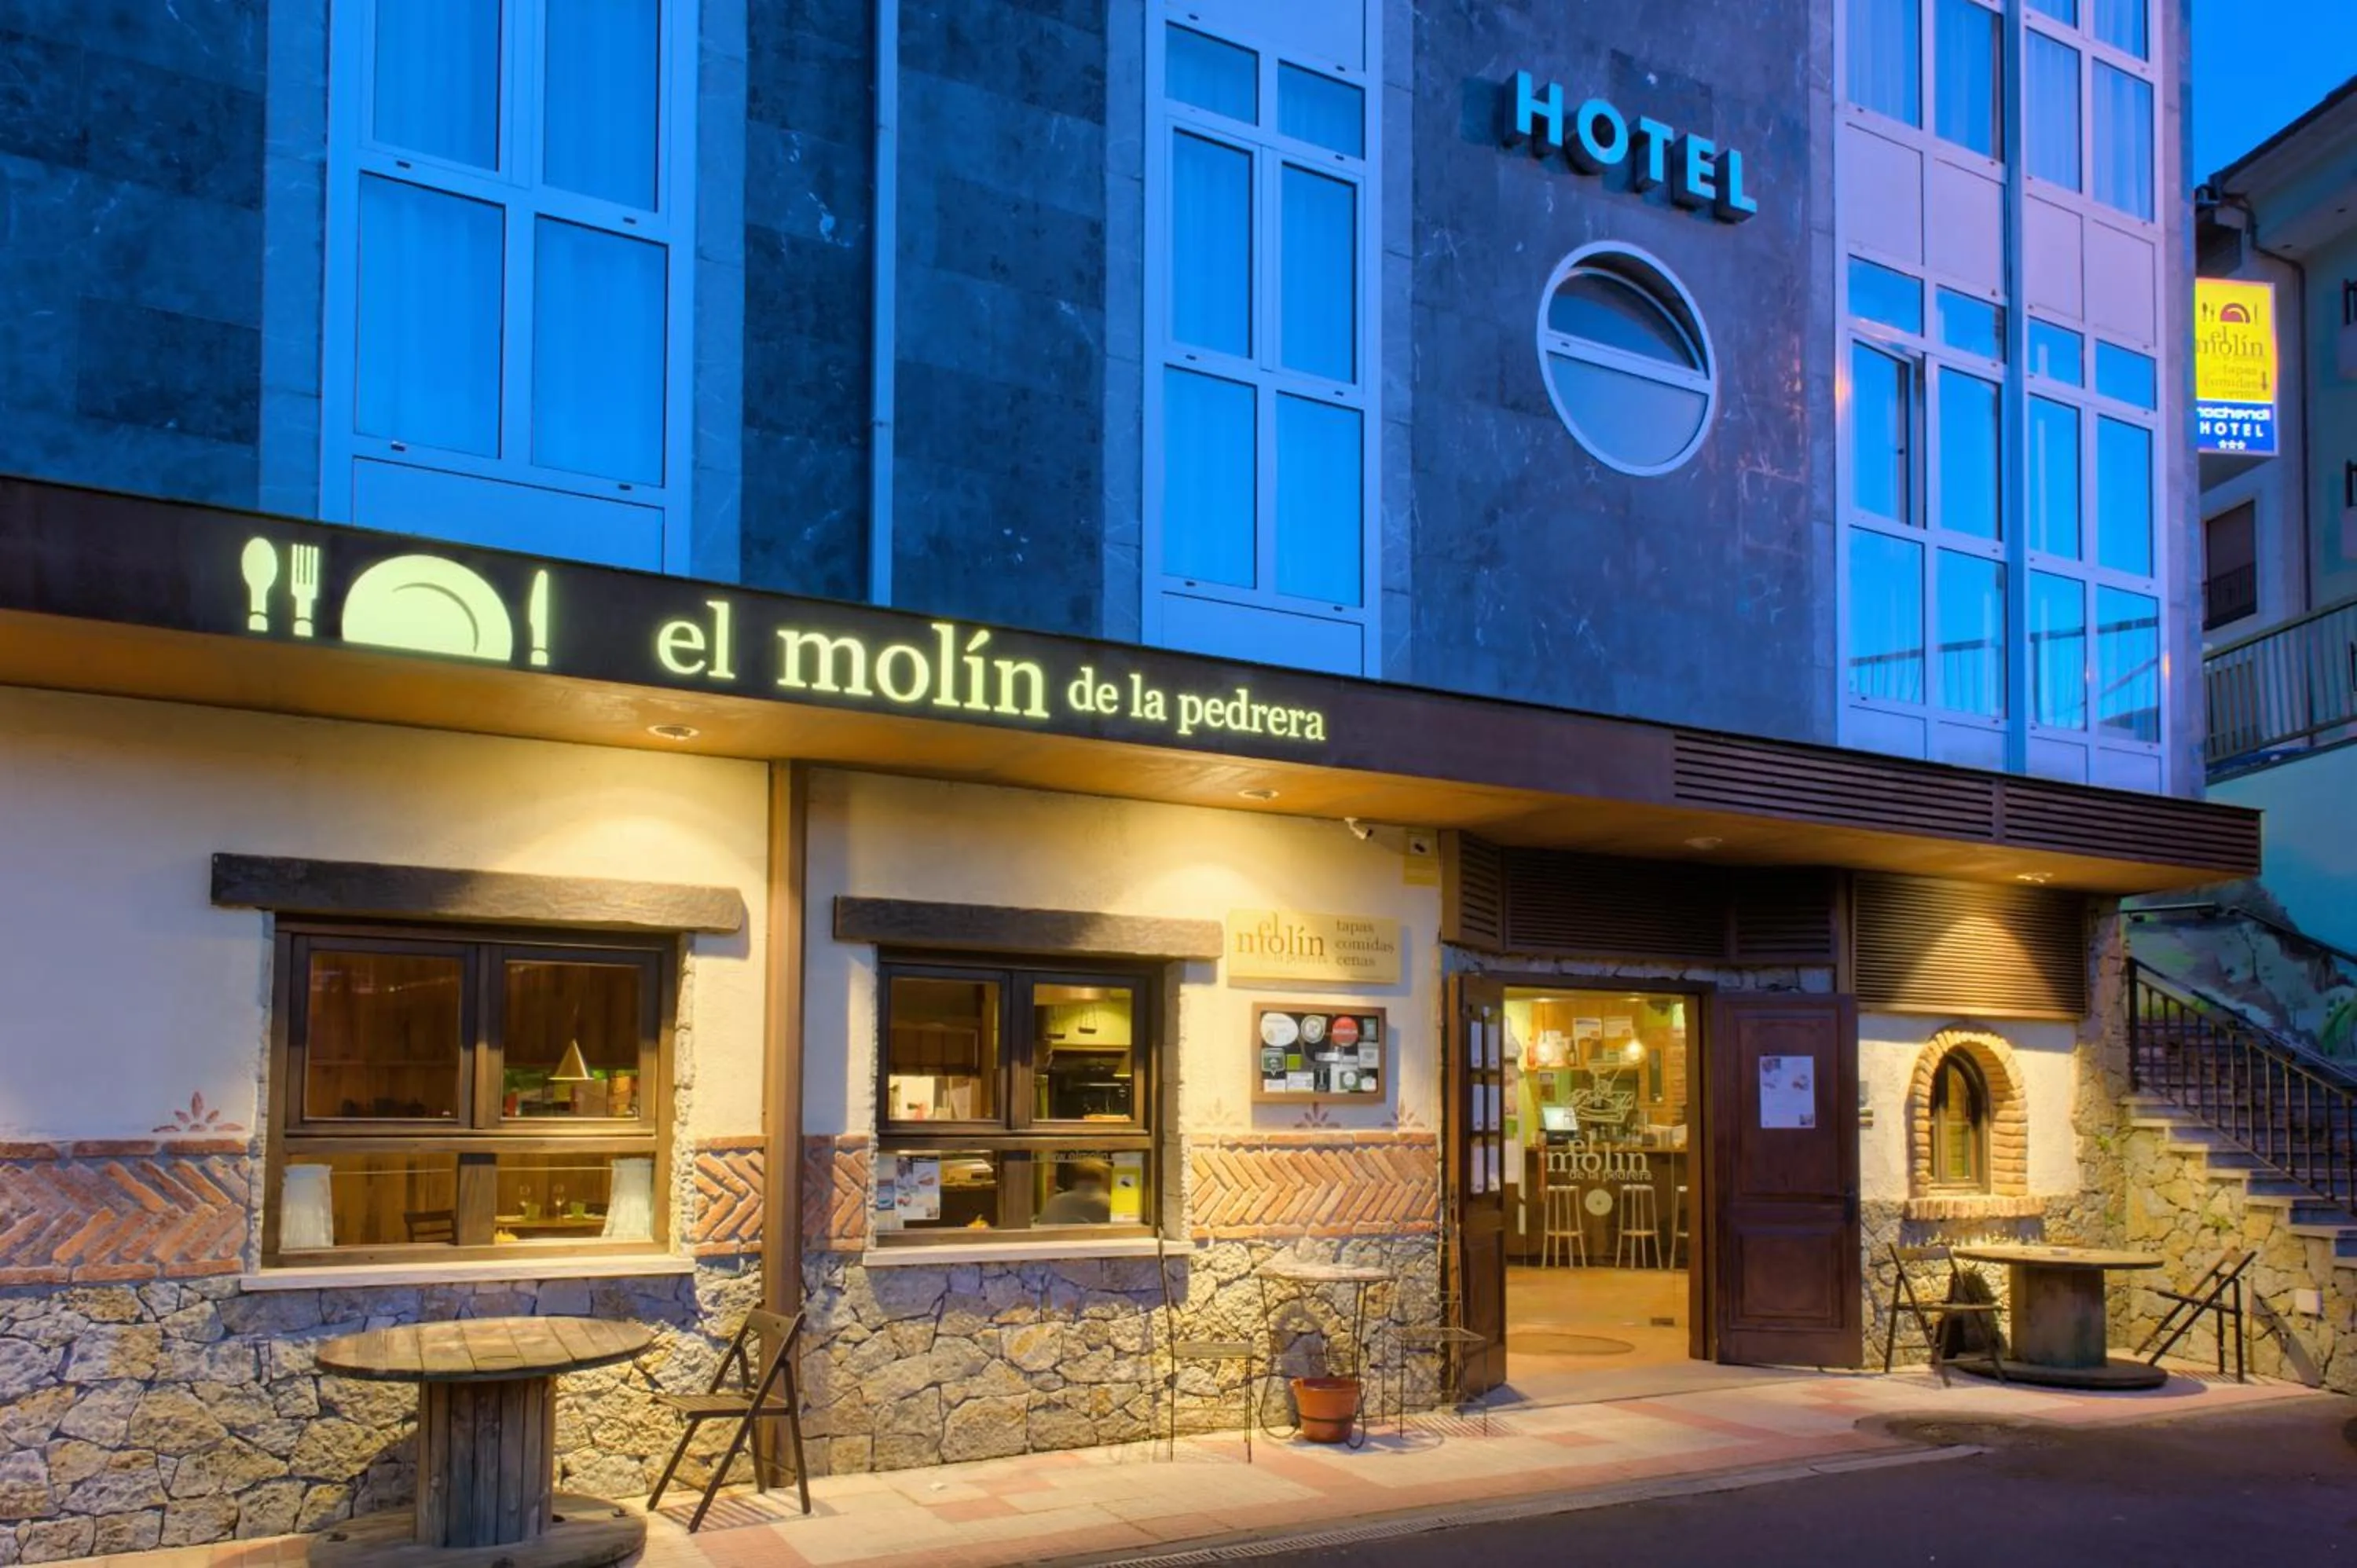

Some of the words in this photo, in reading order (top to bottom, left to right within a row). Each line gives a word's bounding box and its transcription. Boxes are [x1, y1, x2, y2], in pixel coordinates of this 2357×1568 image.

[1516, 68, 1758, 214] HOTEL
[2210, 325, 2227, 343] el
[2199, 420, 2264, 438] HOTEL
[658, 600, 736, 680] el
[775, 622, 1050, 720] molín
[1067, 666, 1120, 714] de
[1128, 673, 1168, 721] la
[1177, 688, 1327, 742] pedrera
[1257, 911, 1279, 939] el
[1336, 918, 1375, 936] tapas
[1236, 924, 1326, 957] molín
[1335, 936, 1395, 954] comidas
[1335, 954, 1376, 967] cenas
